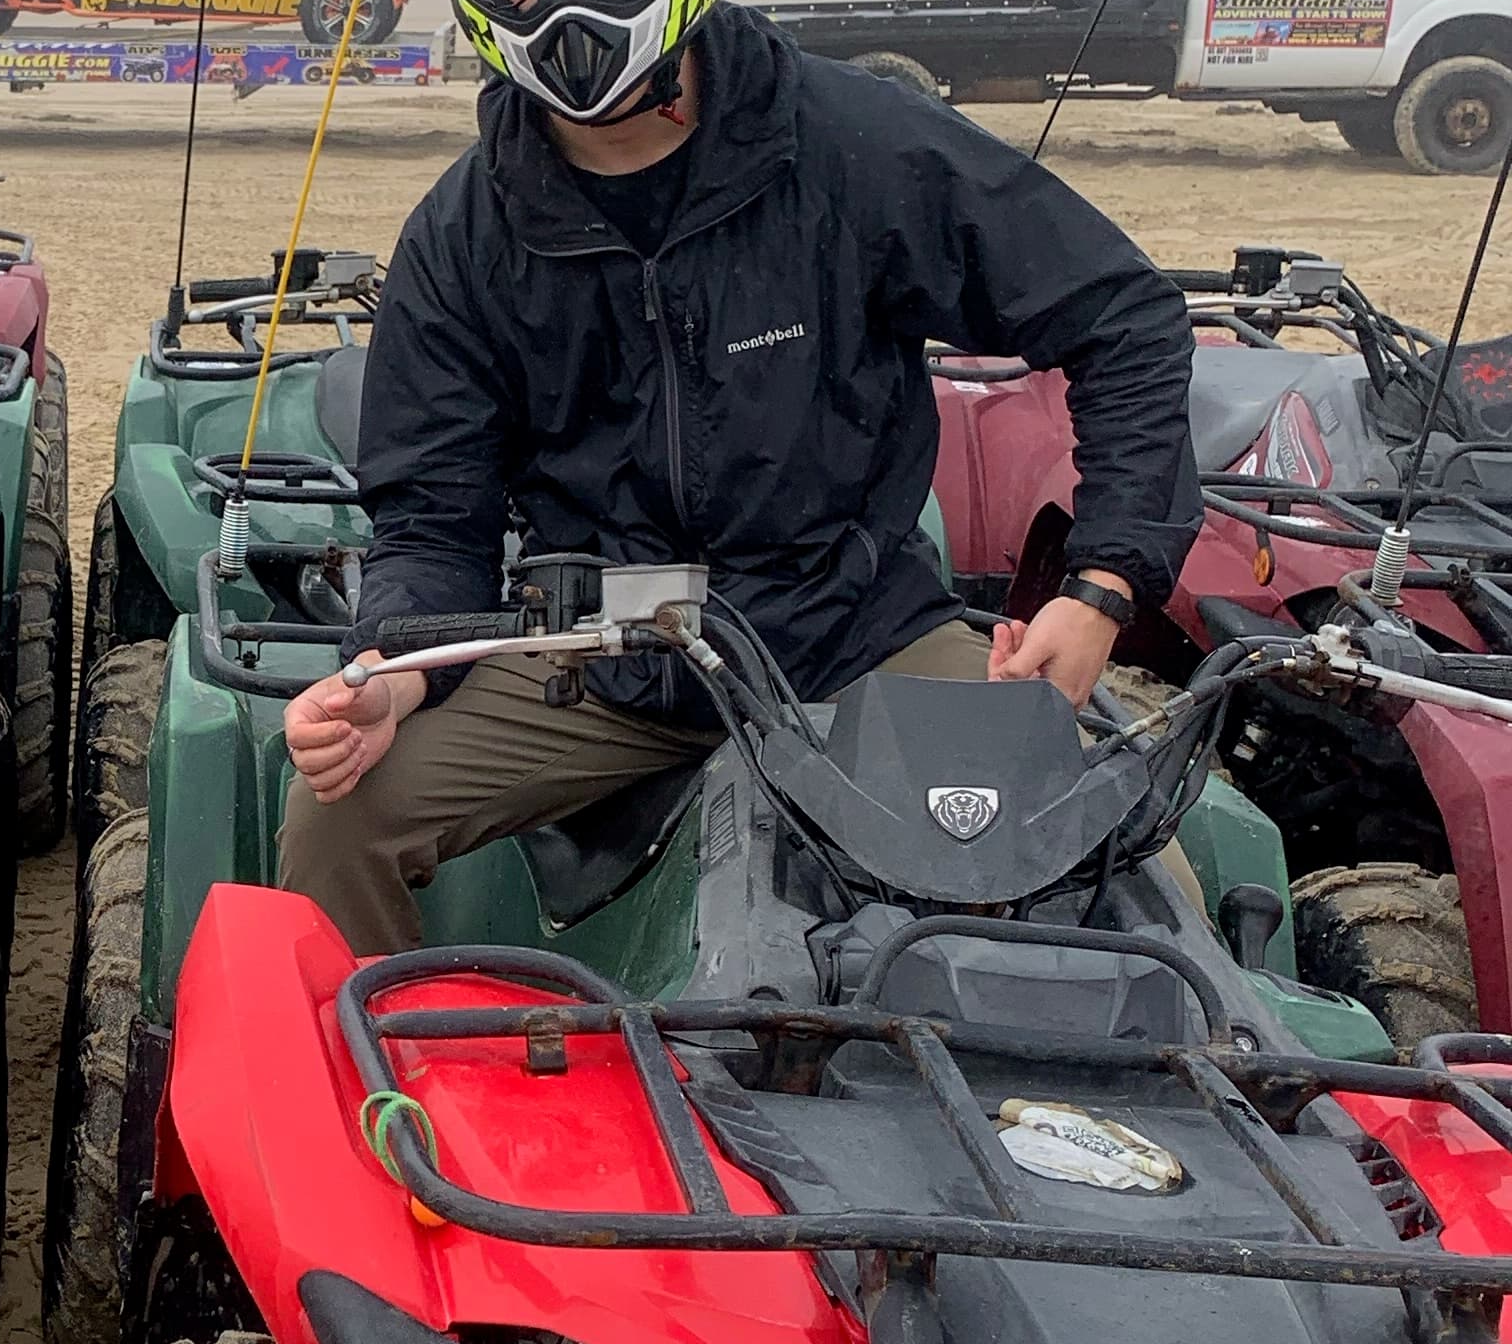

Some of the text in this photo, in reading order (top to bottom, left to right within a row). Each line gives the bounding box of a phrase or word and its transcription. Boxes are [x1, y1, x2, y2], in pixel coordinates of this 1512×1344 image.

[1214, 8, 1387, 19] ADVENTURE STARTS NOW!
